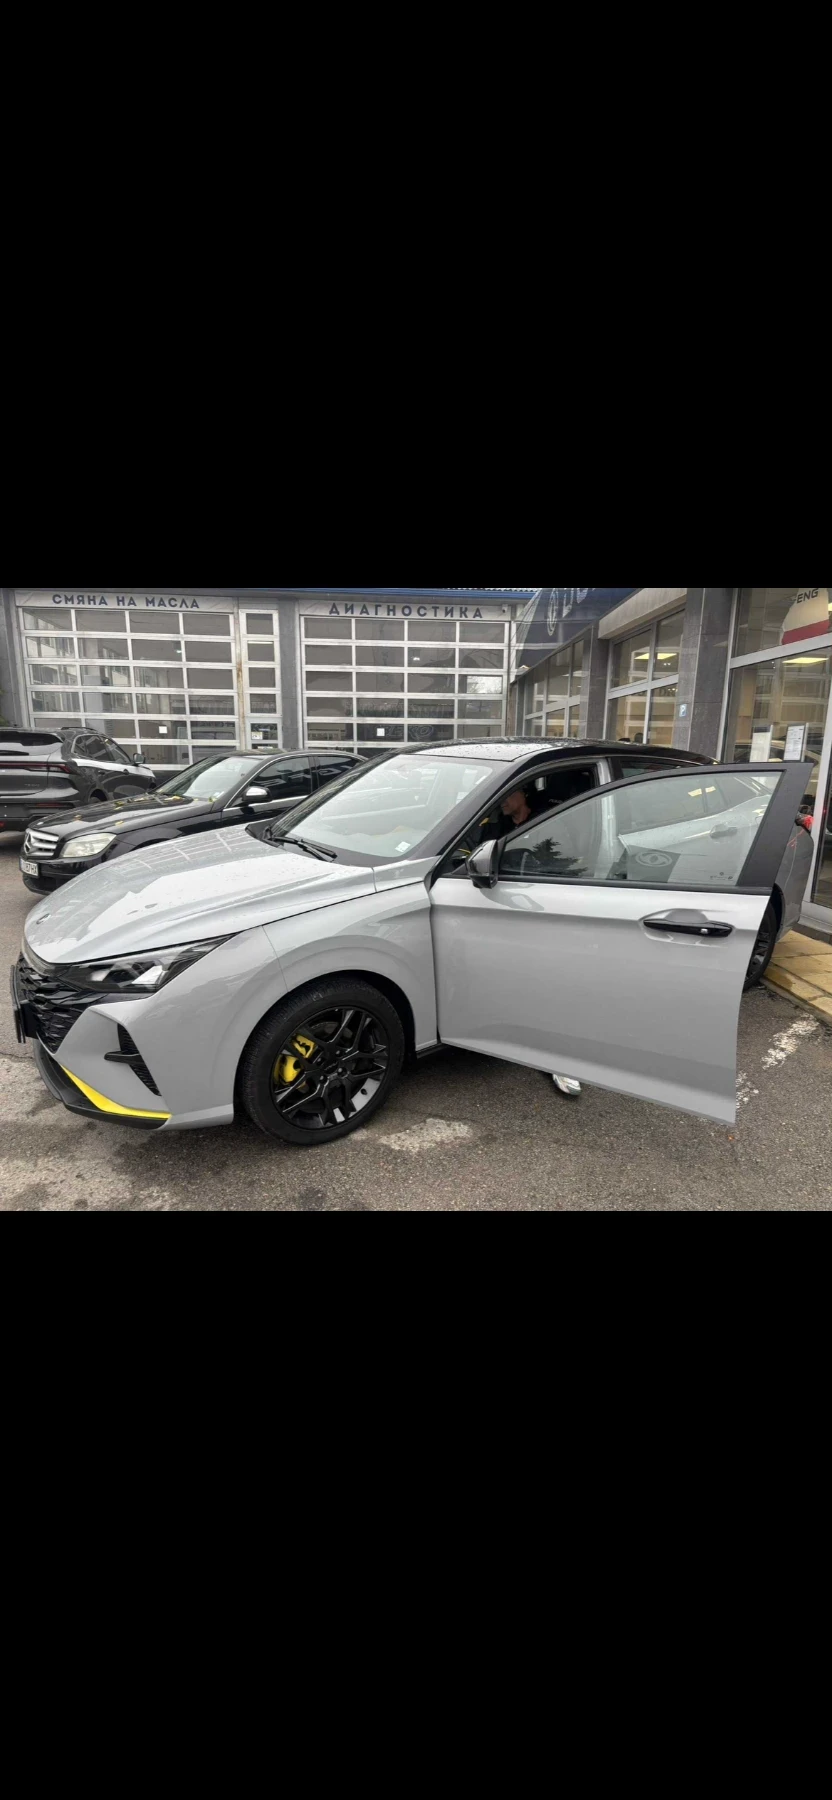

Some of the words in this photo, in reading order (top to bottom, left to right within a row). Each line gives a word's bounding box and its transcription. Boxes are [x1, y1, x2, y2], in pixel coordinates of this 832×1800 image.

[52, 594, 108, 606] СМЯНА
[117, 596, 137, 607] НА
[145, 597, 200, 609] МАСЛА
[796, 588, 819, 604] ENG
[329, 602, 483, 618] ДИАГНОСТИКА
